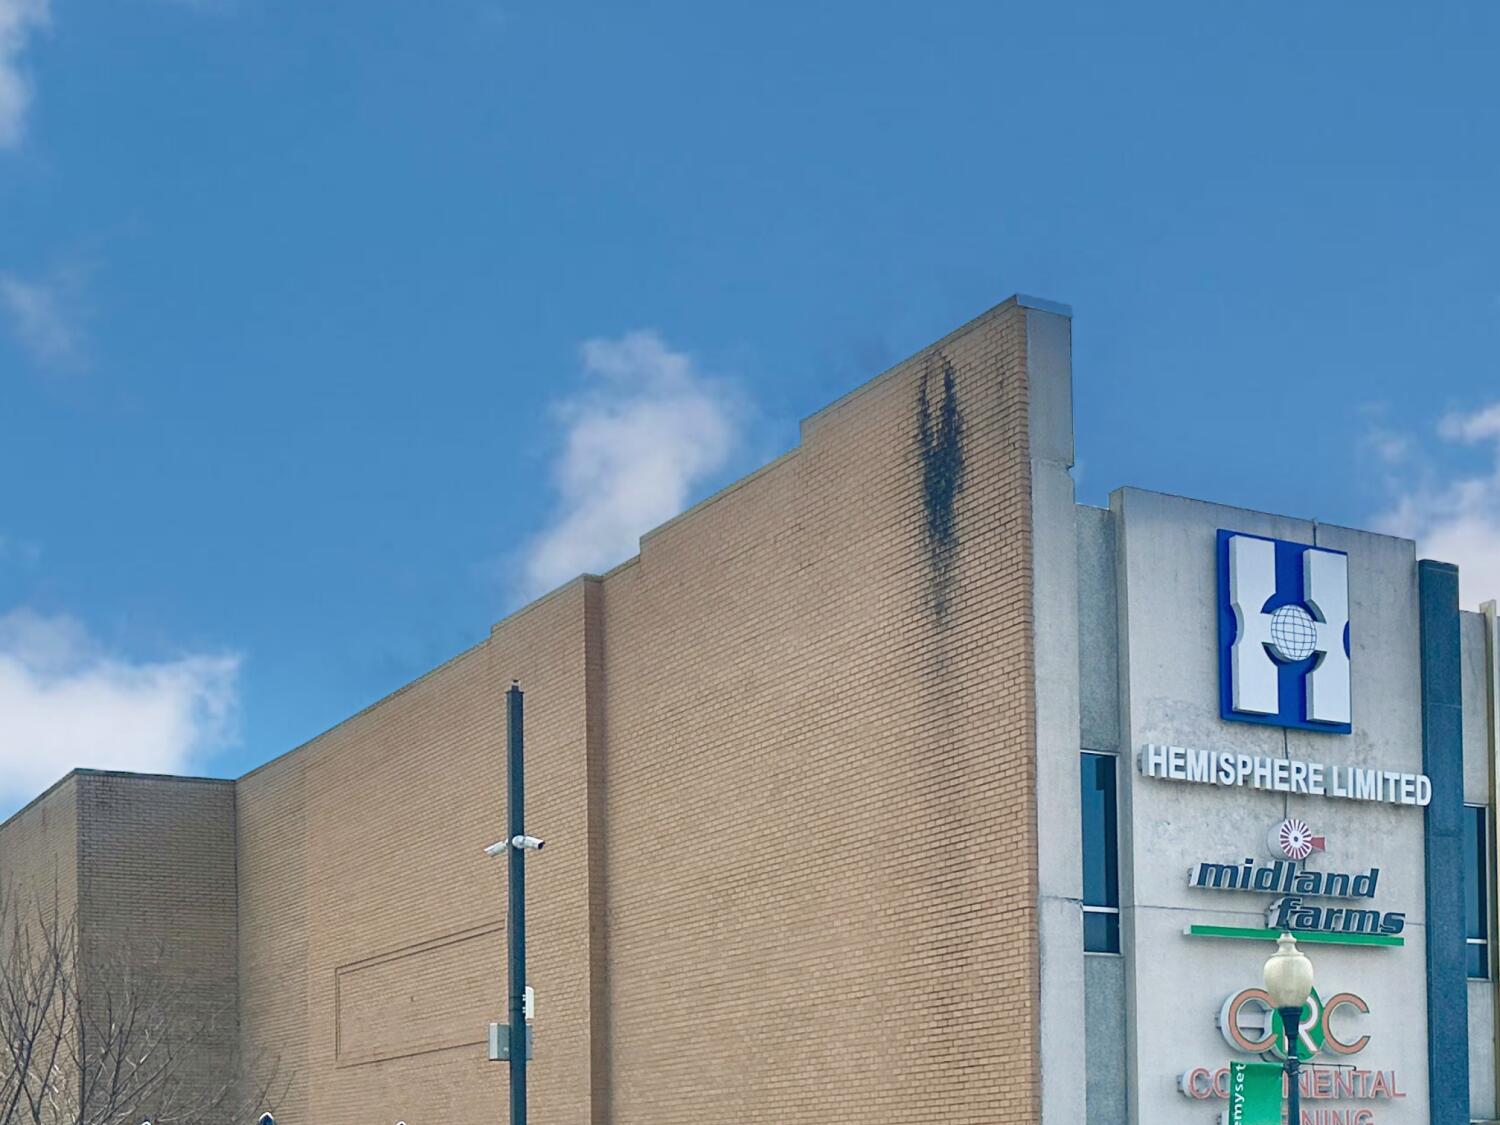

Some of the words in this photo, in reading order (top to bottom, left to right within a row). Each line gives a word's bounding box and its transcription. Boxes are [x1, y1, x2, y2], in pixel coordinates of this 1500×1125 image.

[1148, 743, 1325, 796] HEMISPHERE
[1331, 765, 1432, 807] LIMITED
[1194, 858, 1380, 898] midland
[1272, 897, 1406, 935] farms
[1188, 1067, 1407, 1099] COINENTAL
